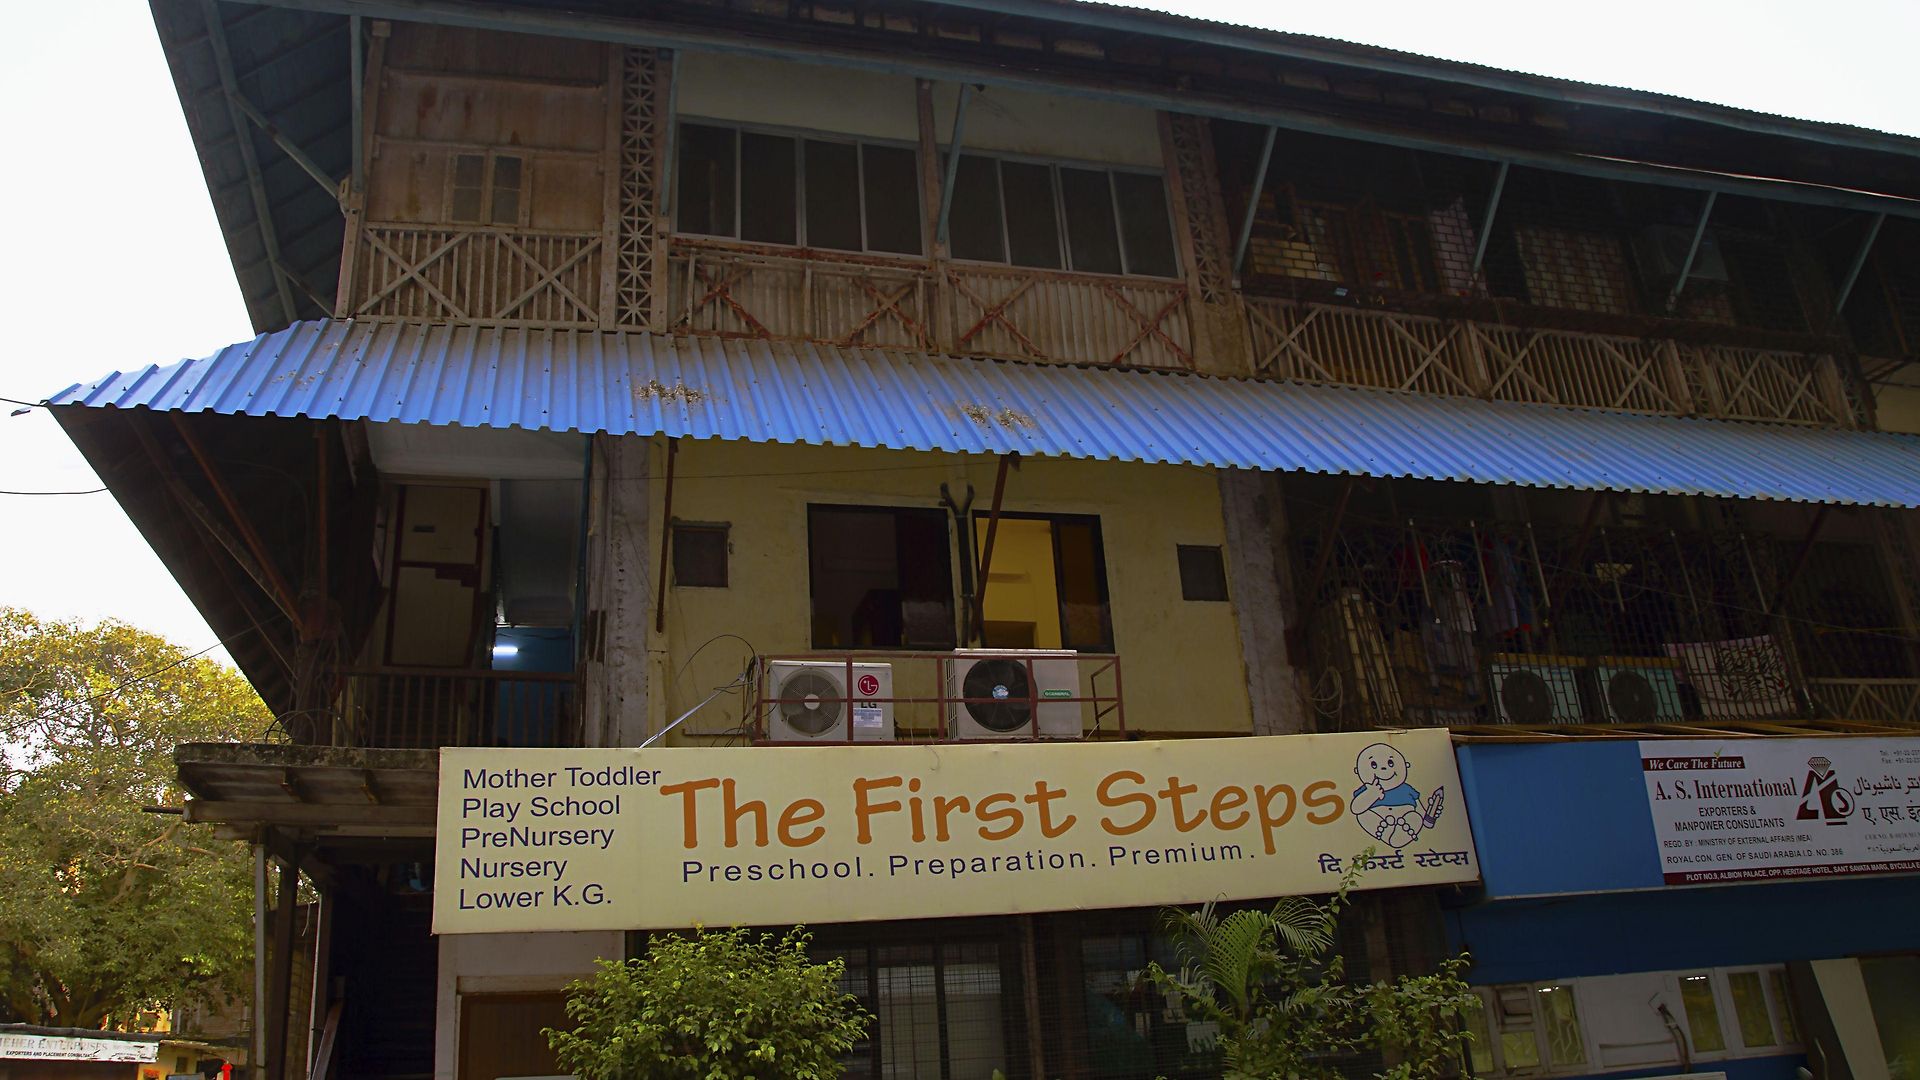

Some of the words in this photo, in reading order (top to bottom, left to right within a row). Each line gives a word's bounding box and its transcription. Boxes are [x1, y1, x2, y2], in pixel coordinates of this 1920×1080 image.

[1649, 759, 1664, 770] We
[1666, 759, 1689, 769] Care
[1691, 758, 1708, 769] The
[1711, 758, 1742, 769] Future
[463, 768, 557, 789] Mother
[565, 766, 662, 787] Toddler
[1655, 781, 1672, 800] A.
[1674, 779, 1692, 800] S.
[1694, 777, 1798, 799] International
[462, 798, 521, 823] Play
[530, 794, 620, 817] School
[660, 778, 826, 849] The
[853, 775, 1078, 844] First
[1097, 770, 1345, 856] Steps
[1699, 806, 1749, 817] EXPORTERS
[1749, 805, 1757, 815] &
[1674, 820, 1724, 832] MANPOWER
[1725, 818, 1785, 830] CONSULTANTS
[462, 826, 615, 850] PreNursery
[1699, 837, 1726, 846] MINISTRY
[1727, 837, 1736, 845] OF
[1737, 836, 1770, 845] EXTERNAL
[1770, 834, 1795, 843] AFFAIRS
[683, 856, 874, 883] Preschool.
[889, 850, 1096, 879] Preparation.
[1109, 844, 1255, 866] Premium.
[1318, 853, 1343, 874] दि
[1413, 848, 1469, 868] स्टेप्स
[1667, 855, 1694, 864] ROYAL
[1695, 854, 1714, 863] CON.
[1736, 852, 1747, 860] OF
[1748, 851, 1772, 860] SAUDI
[1773, 849, 1801, 859] ARABIA
[460, 857, 568, 882] Nursery
[1686, 873, 1703, 881] PLOT
[1720, 871, 1743, 880] ALBION
[1743, 869, 1769, 879] PALACE,
[1769, 868, 1782, 877] OPP.
[1782, 867, 1812, 876] HERITAGE
[1812, 865, 1833, 875] HOTEL,
[1833, 865, 1849, 873] SANT
[1890, 861, 1916, 871] BYCULLA
[459, 886, 545, 910] Lower
[553, 883, 612, 907] K.G.
